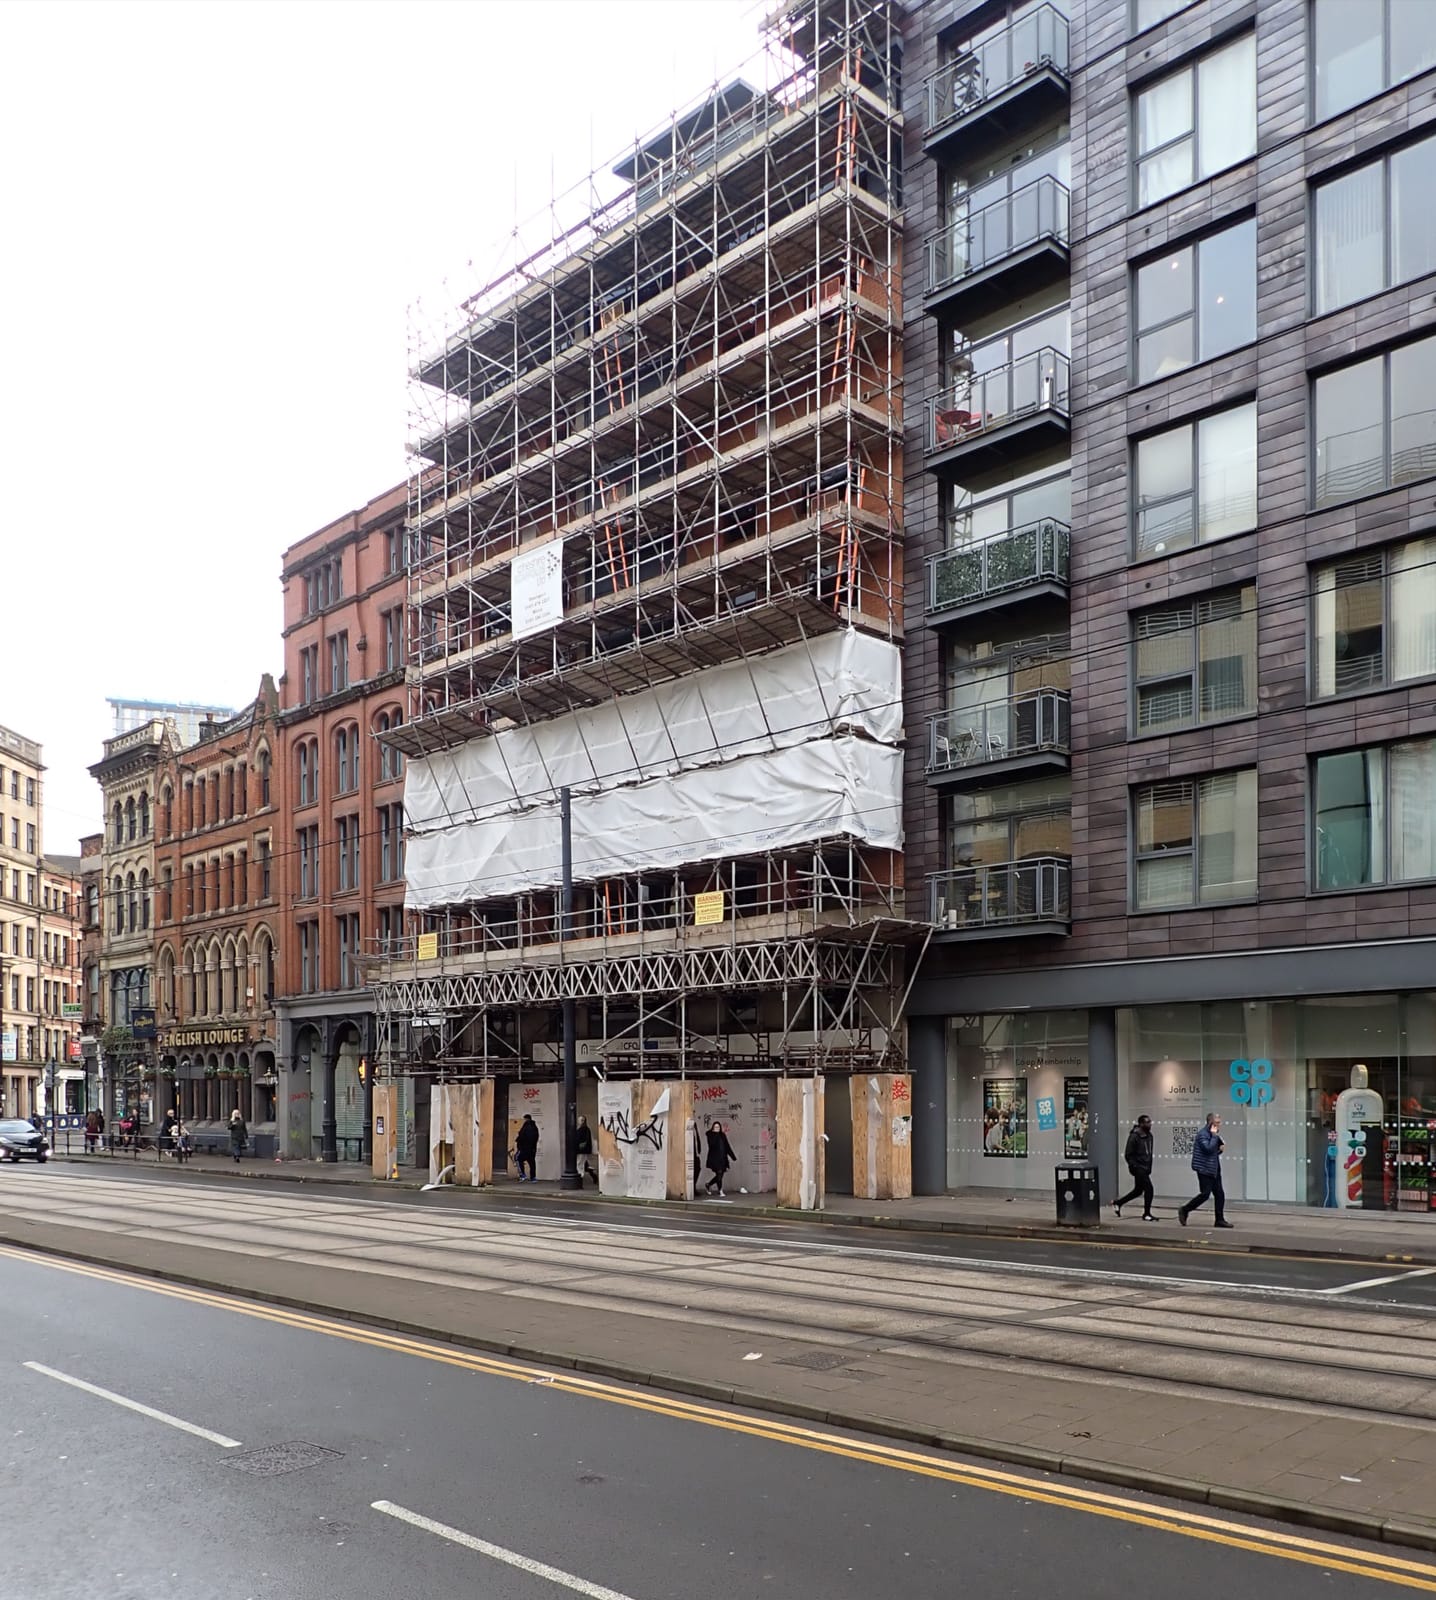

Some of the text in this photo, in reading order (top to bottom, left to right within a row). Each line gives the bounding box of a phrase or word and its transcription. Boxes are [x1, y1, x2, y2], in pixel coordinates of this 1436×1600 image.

[164, 1028, 245, 1047] ENGLISH LOUNGE
[1037, 1055, 1082, 1067] Membership
[1168, 1085, 1201, 1094] Join Us
